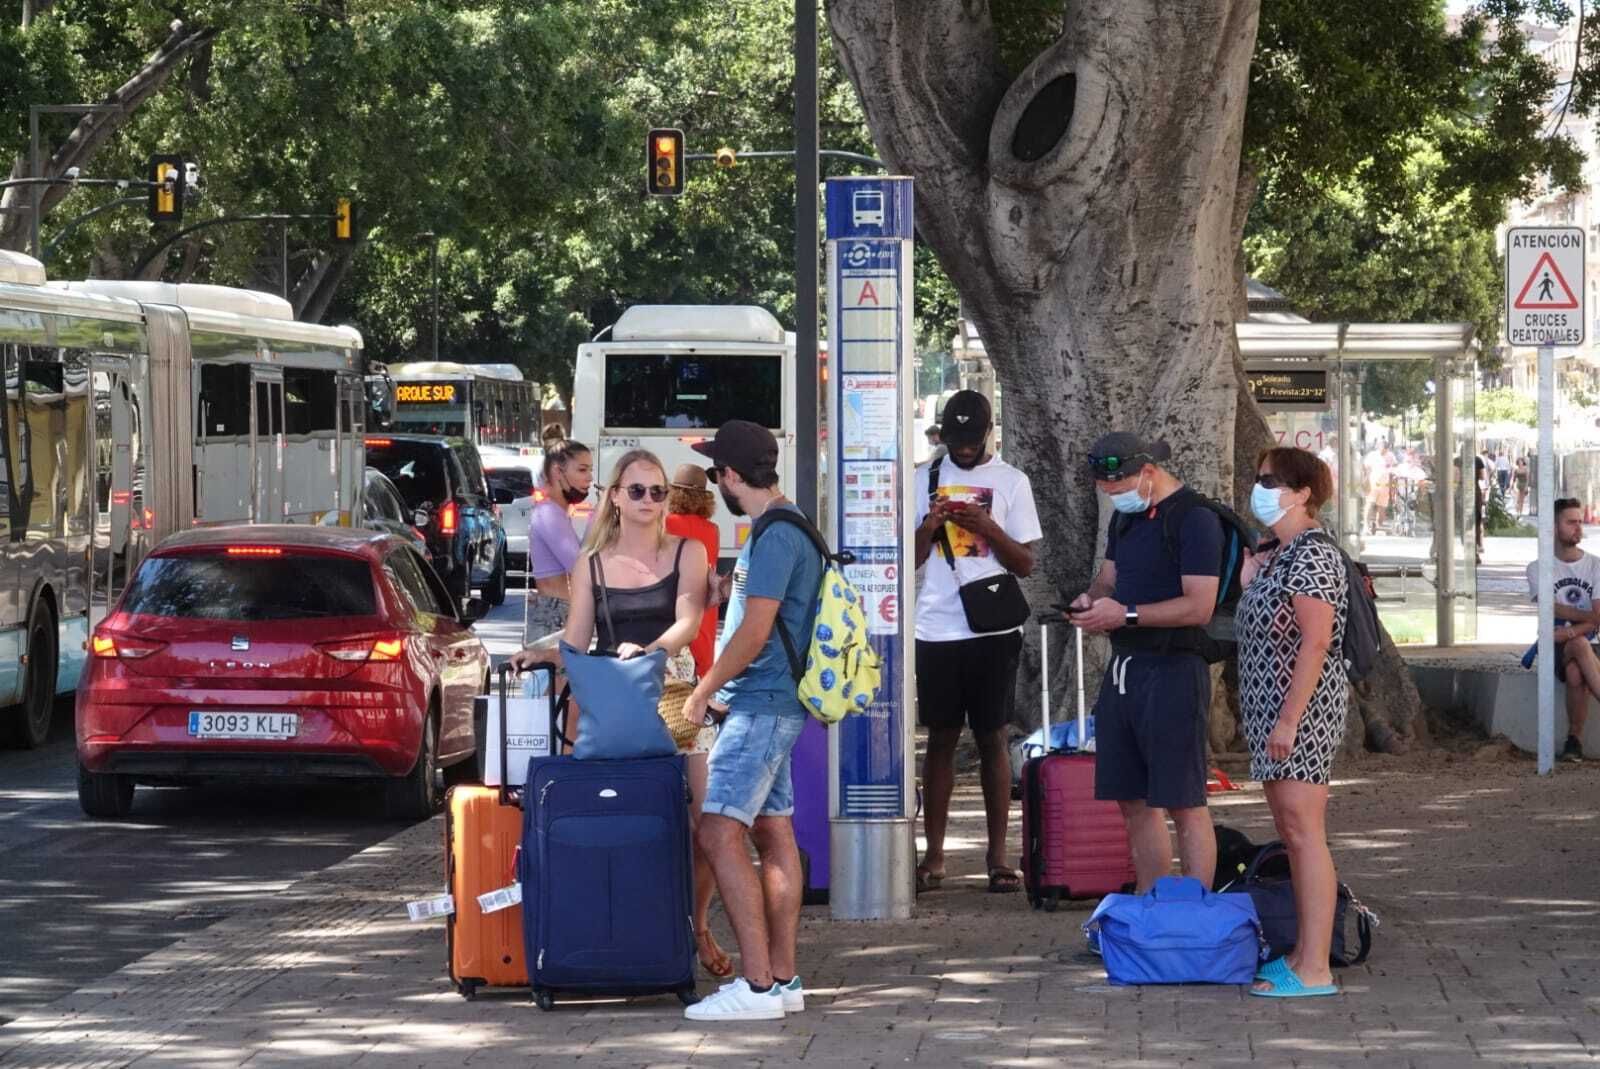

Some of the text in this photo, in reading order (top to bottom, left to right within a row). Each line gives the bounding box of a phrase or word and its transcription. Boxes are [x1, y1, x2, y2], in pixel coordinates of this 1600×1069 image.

[1513, 232, 1580, 248] ATENCIÓN
[857, 280, 879, 306] A
[1525, 313, 1567, 327] CRUCES
[1512, 328, 1580, 342] PEATONALES
[433, 385, 456, 401] SUR
[1295, 430, 1324, 450] C1
[203, 715, 292, 733] 3093 KLH
